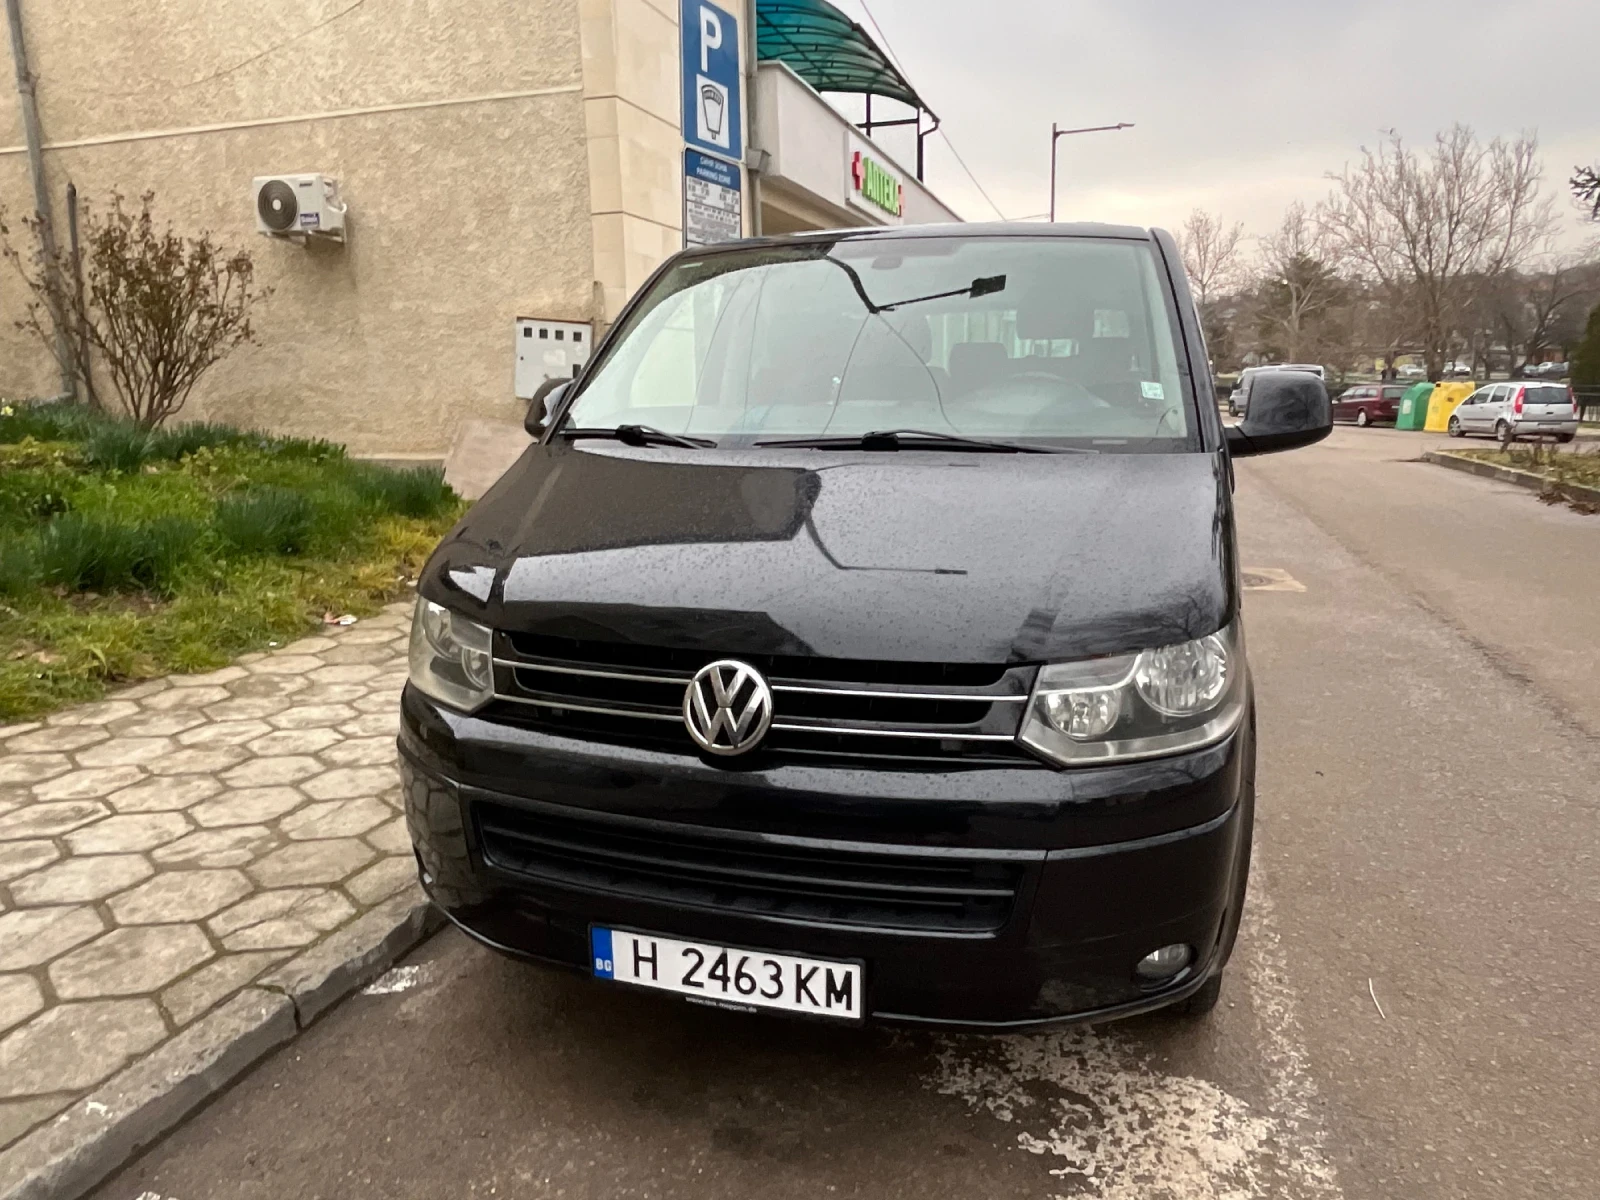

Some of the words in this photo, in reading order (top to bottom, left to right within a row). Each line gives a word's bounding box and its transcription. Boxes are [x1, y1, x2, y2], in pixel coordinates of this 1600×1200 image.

[700, 5, 723, 73] P
[696, 167, 718, 181] PARKING
[718, 174, 731, 185] ZONE
[595, 957, 612, 972] BG
[632, 938, 658, 981] H
[681, 947, 784, 1000] 2463
[795, 963, 853, 1011] KM
